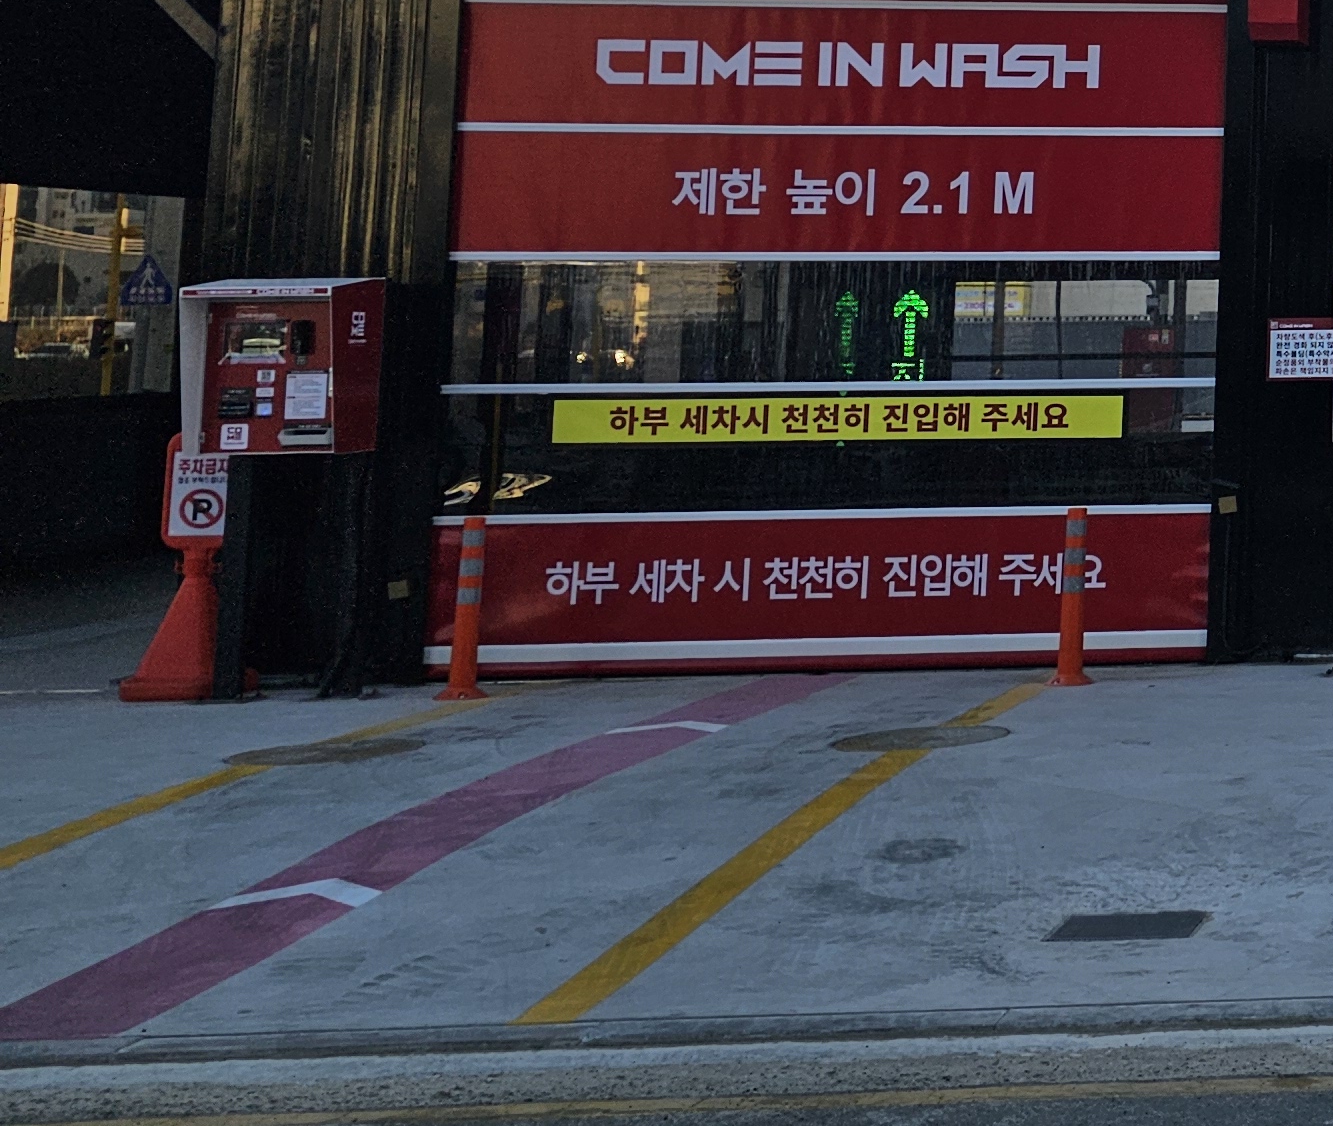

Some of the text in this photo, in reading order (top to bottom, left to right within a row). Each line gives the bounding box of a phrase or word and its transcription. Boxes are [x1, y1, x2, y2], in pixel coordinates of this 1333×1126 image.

[596, 39, 1100, 90] COME IN WASH
[671, 166, 1035, 216] 제한 높이 2.1 M
[608, 401, 1070, 436] 하부 세차시 천천히 진입해 주세요
[178, 458, 229, 475] 주차금지
[544, 552, 1107, 606] 하부 세차 시 천천히 진입해 주세요
